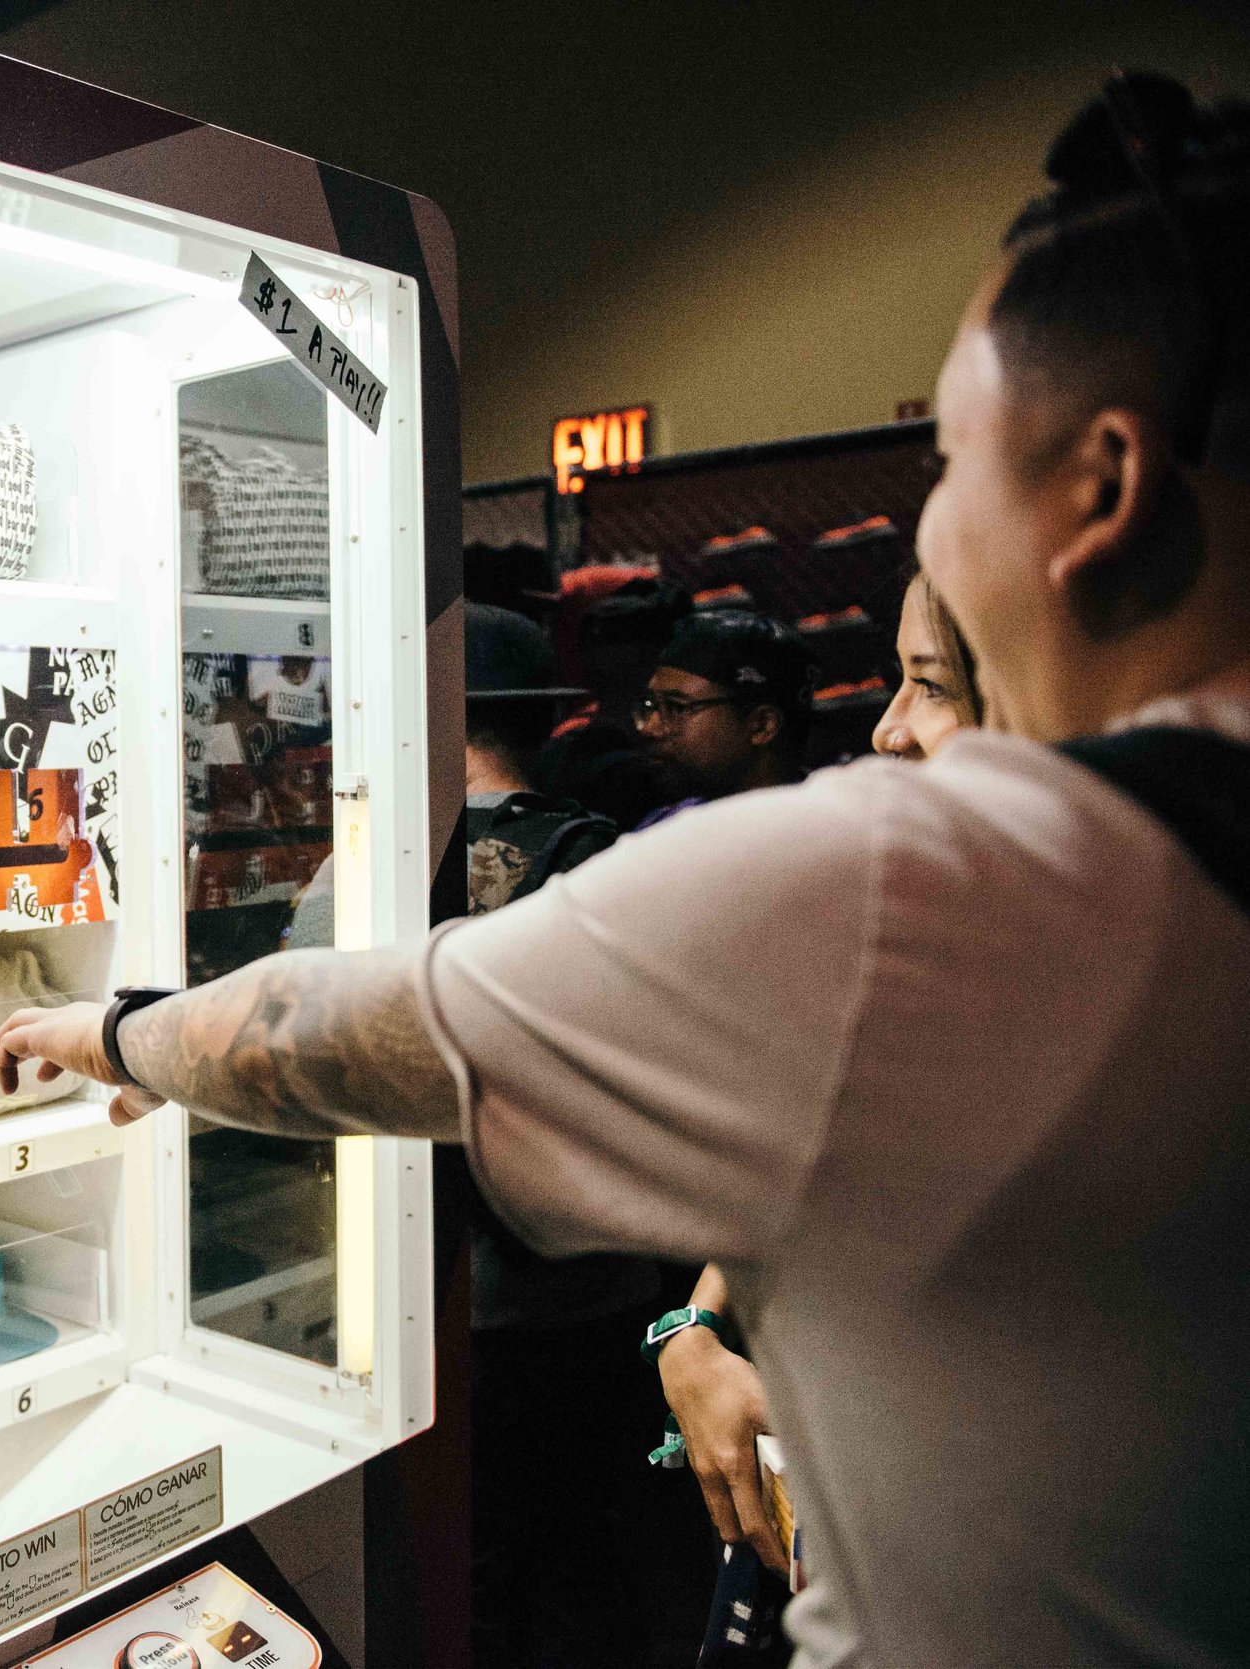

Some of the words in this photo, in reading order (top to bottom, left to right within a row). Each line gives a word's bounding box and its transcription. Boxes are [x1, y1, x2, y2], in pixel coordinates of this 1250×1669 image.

[308, 324, 323, 363] A
[553, 407, 648, 495] EXIT
[29, 788, 44, 822] 6
[14, 1146, 31, 1172] 3
[18, 1387, 31, 1413] 6
[100, 1486, 153, 1524] CÓMO
[156, 1461, 207, 1498] GANAR
[24, 1530, 56, 1560] WIN
[138, 1641, 176, 1665] Press
